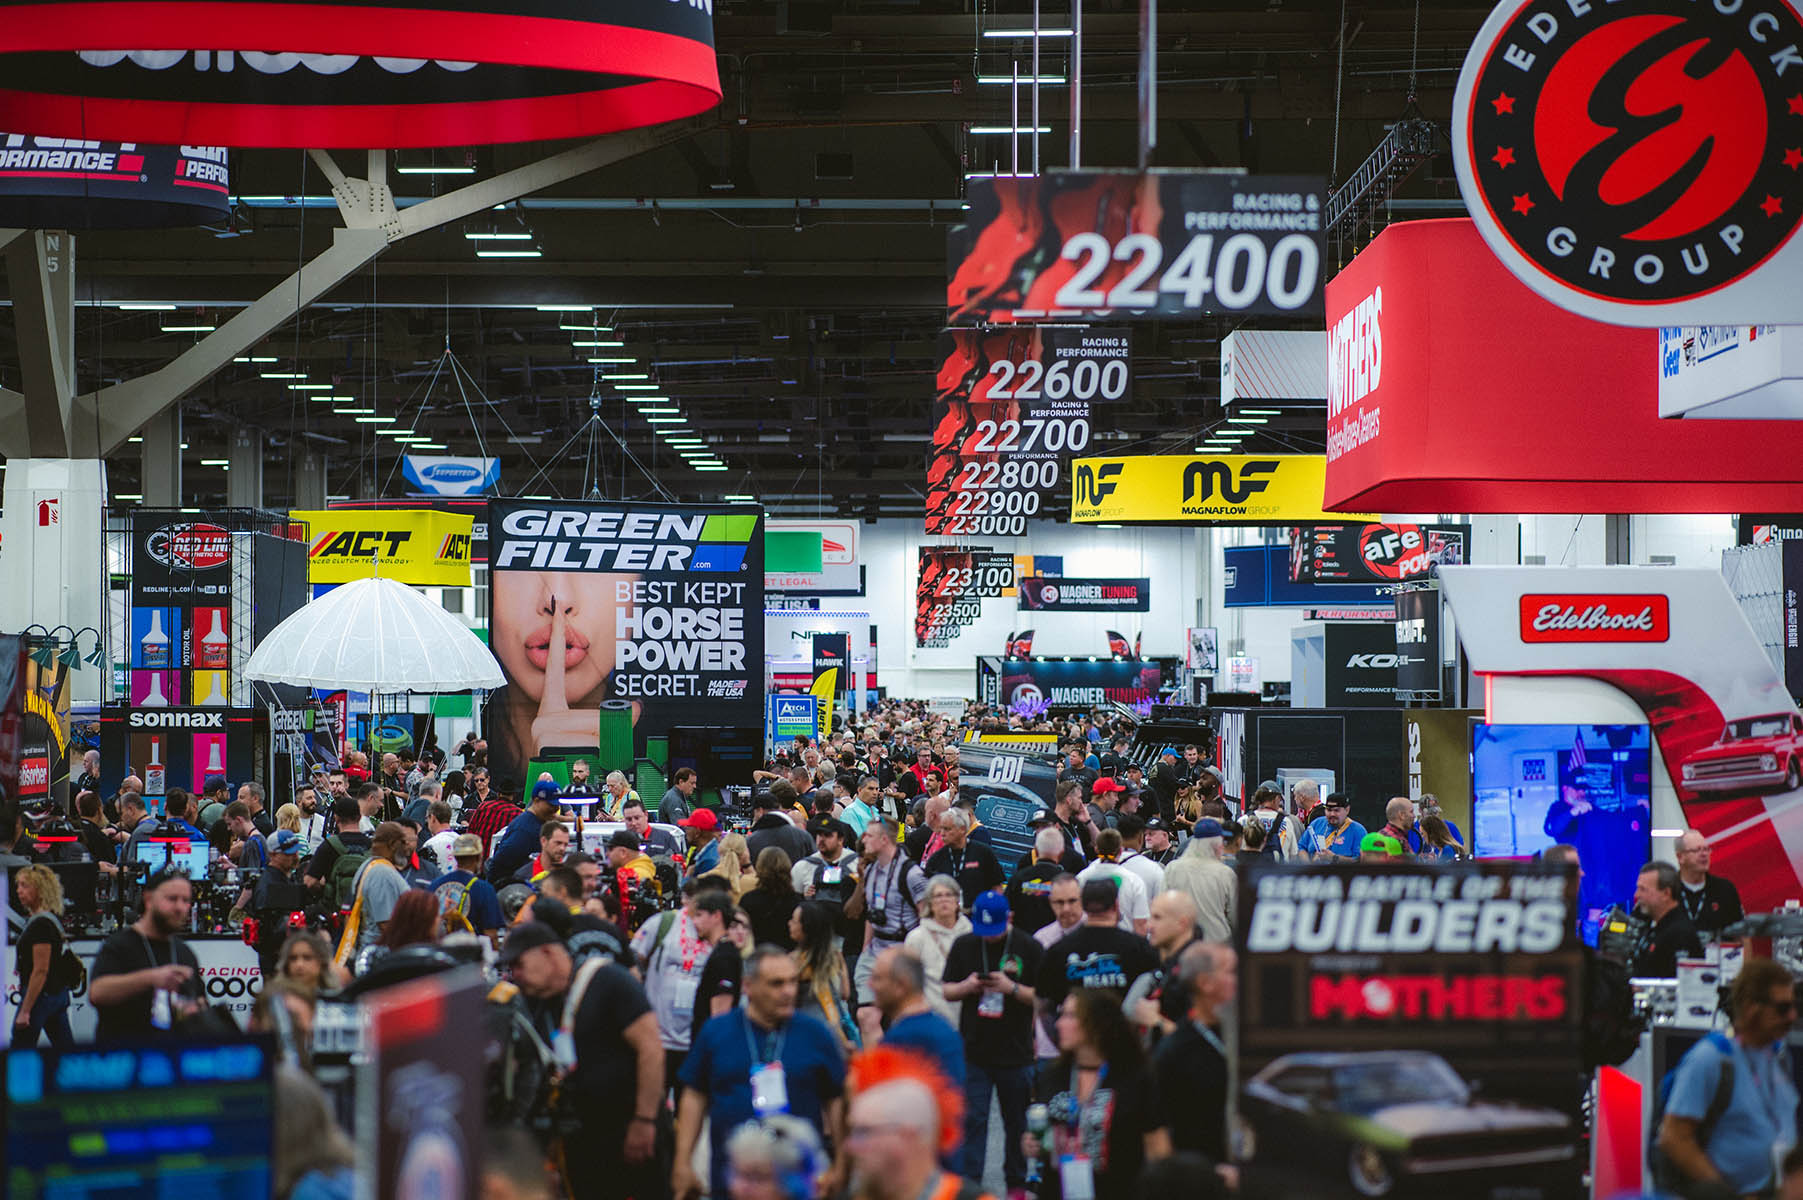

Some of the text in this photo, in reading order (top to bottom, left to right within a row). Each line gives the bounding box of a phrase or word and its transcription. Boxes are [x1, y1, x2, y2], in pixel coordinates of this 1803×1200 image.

[0, 148, 116, 170] RMANCE
[1233, 193, 1319, 211] RACING &
[1185, 212, 1319, 231] PERFORMANCE
[46, 236, 60, 251] N
[1546, 224, 1744, 284] GROUP
[47, 256, 59, 272] 5
[1055, 232, 1320, 310] 22400
[1056, 348, 1128, 357] PERFORMANCE
[1082, 338, 1128, 347] RACING &
[1328, 285, 1382, 421] MOTHERS
[986, 360, 1128, 400] 22600
[1030, 409, 1089, 417] PERFORMANCE
[974, 418, 1089, 452] 22700
[961, 461, 1059, 489] 22800
[955, 491, 1040, 515] 22900
[1182, 506, 1280, 515] MAGNAFLOW GROUP
[502, 510, 706, 540] GREEN
[951, 516, 1025, 535] 23000
[174, 537, 201, 552] RED
[319, 531, 411, 557] ACT
[444, 533, 470, 560] ACT
[1364, 531, 1420, 560] aFe
[496, 540, 692, 571] FILTER
[946, 568, 1013, 587] 23100
[616, 581, 745, 603] BEST KEPT
[1060, 586, 1137, 598] WAGNERTUNING
[934, 604, 980, 617] 23500
[1533, 604, 1653, 631] Edelbrock
[616, 607, 744, 640] HORSE
[927, 625, 960, 637] 24100
[616, 641, 746, 671] POWER
[815, 659, 843, 667] HAWK
[1346, 654, 1398, 668] KO
[615, 674, 701, 696] SECRET.
[707, 688, 743, 697] THE USA
[709, 680, 735, 688] MADE
[129, 712, 222, 728] sonnax
[988, 756, 1024, 783] CDI
[1348, 876, 1453, 899] BATTLE
[1461, 876, 1502, 899] OF
[1511, 876, 1565, 899] THE
[1248, 900, 1566, 951] BUILDERS
[1310, 975, 1566, 1019] MOTHERS
